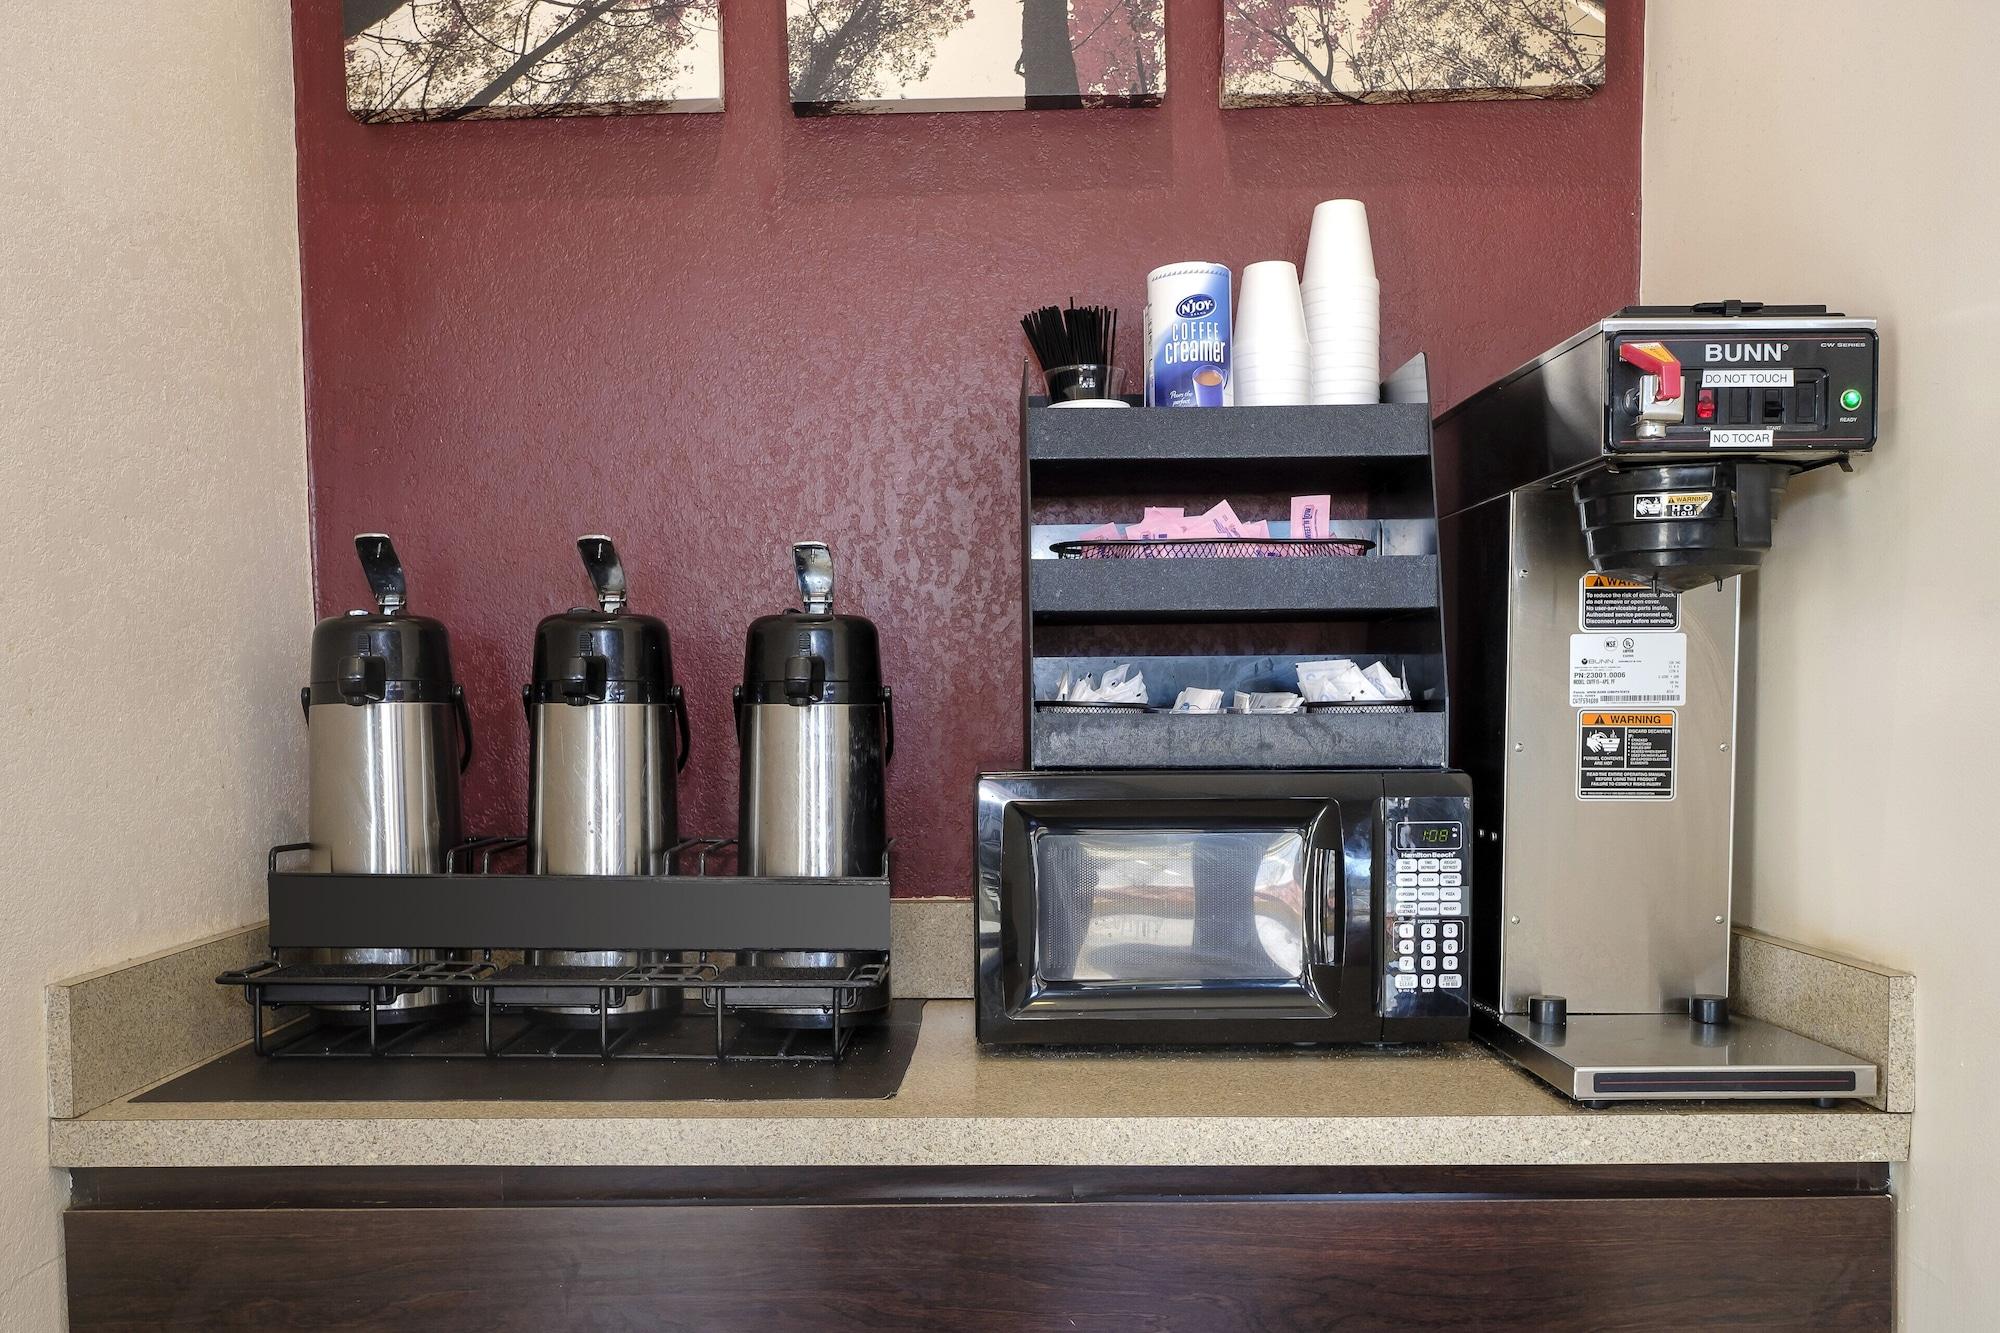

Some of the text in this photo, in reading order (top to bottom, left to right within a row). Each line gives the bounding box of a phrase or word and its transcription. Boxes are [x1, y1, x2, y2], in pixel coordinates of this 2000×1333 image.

[1172, 322, 1219, 342] COFFEE
[1165, 341, 1226, 365] creamer
[1705, 343, 1782, 362] BUNN
[1705, 373, 1788, 384] DO NOT TOUCH
[1713, 434, 1770, 443] NO TOCAR
[1672, 504, 1699, 512] HO
[1610, 715, 1661, 724] WARNING
[1423, 829, 1449, 842] 1:08
